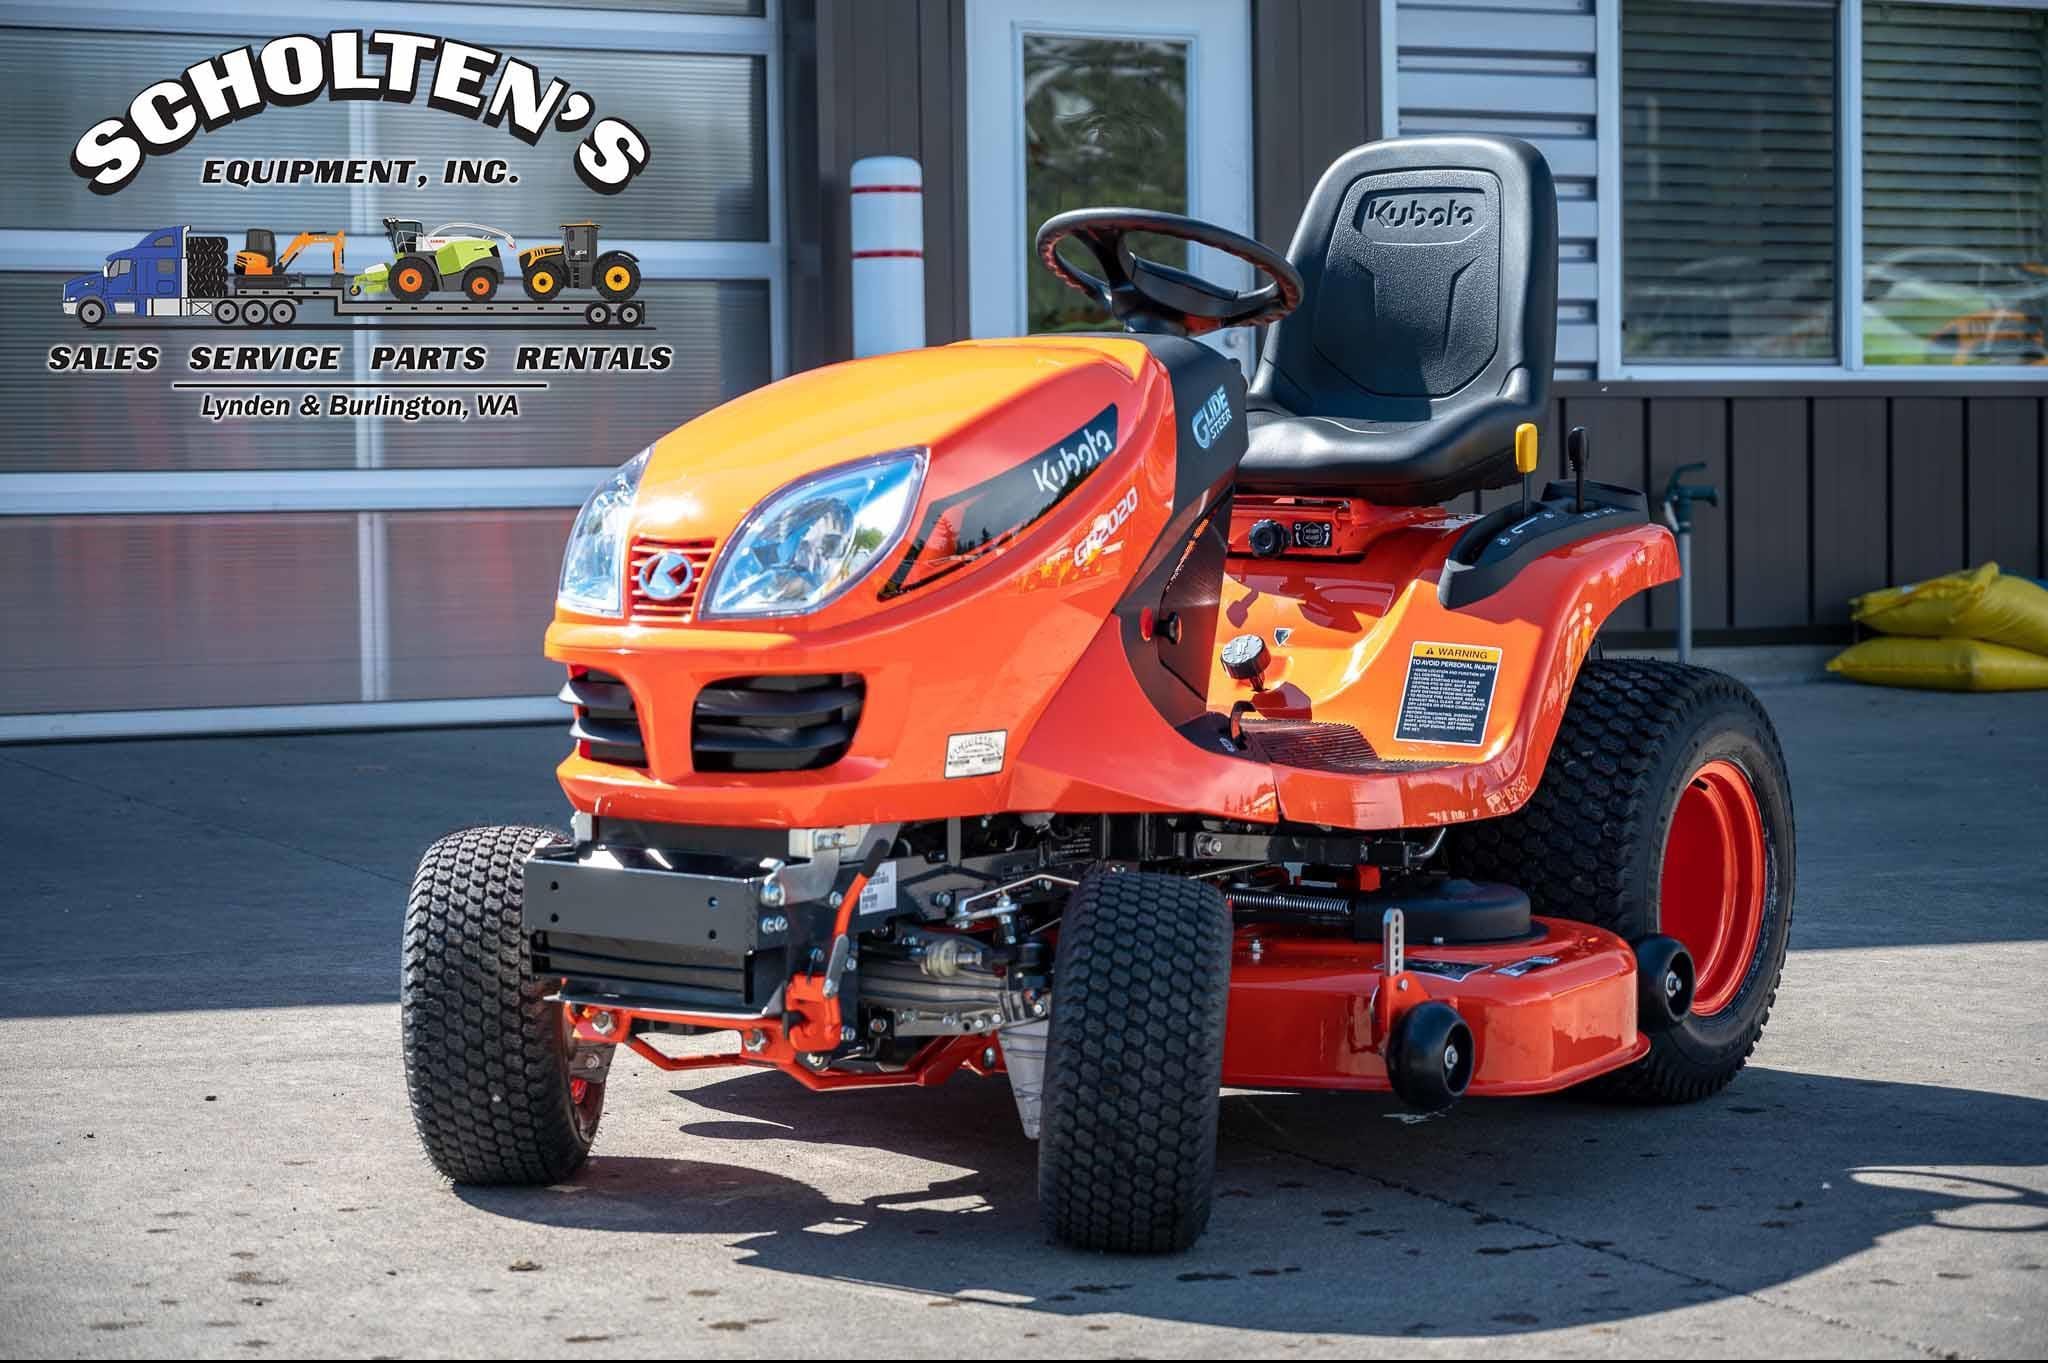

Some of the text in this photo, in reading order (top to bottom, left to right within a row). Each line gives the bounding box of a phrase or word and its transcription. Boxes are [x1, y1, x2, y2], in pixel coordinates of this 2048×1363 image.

[1366, 199, 1475, 228] Kubota
[1210, 408, 1233, 440] STEER
[1032, 427, 1113, 492] Kubota
[1438, 648, 1487, 658] WARNING
[1441, 661, 1473, 669] PERSONAL
